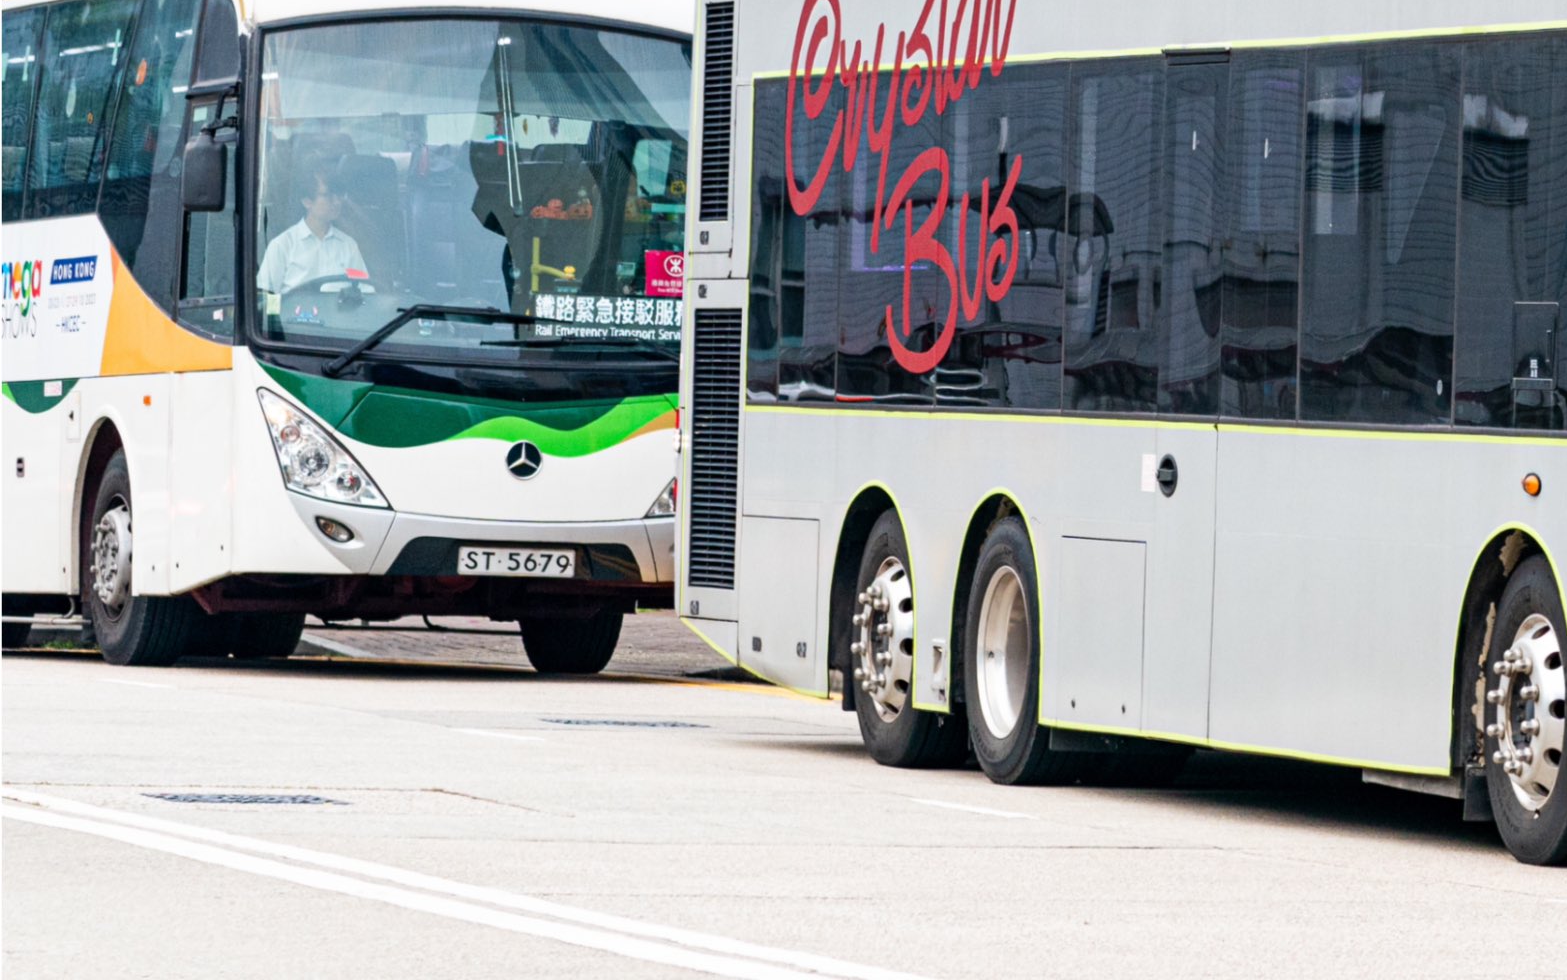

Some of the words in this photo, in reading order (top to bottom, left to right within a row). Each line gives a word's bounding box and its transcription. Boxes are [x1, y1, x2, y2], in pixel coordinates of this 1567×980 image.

[53, 263, 73, 280] HONG
[75, 260, 95, 278] KONG
[884, 146, 1022, 374] Bus
[535, 324, 552, 337] Rail
[465, 551, 495, 570] ST
[507, 553, 570, 573] 5679
